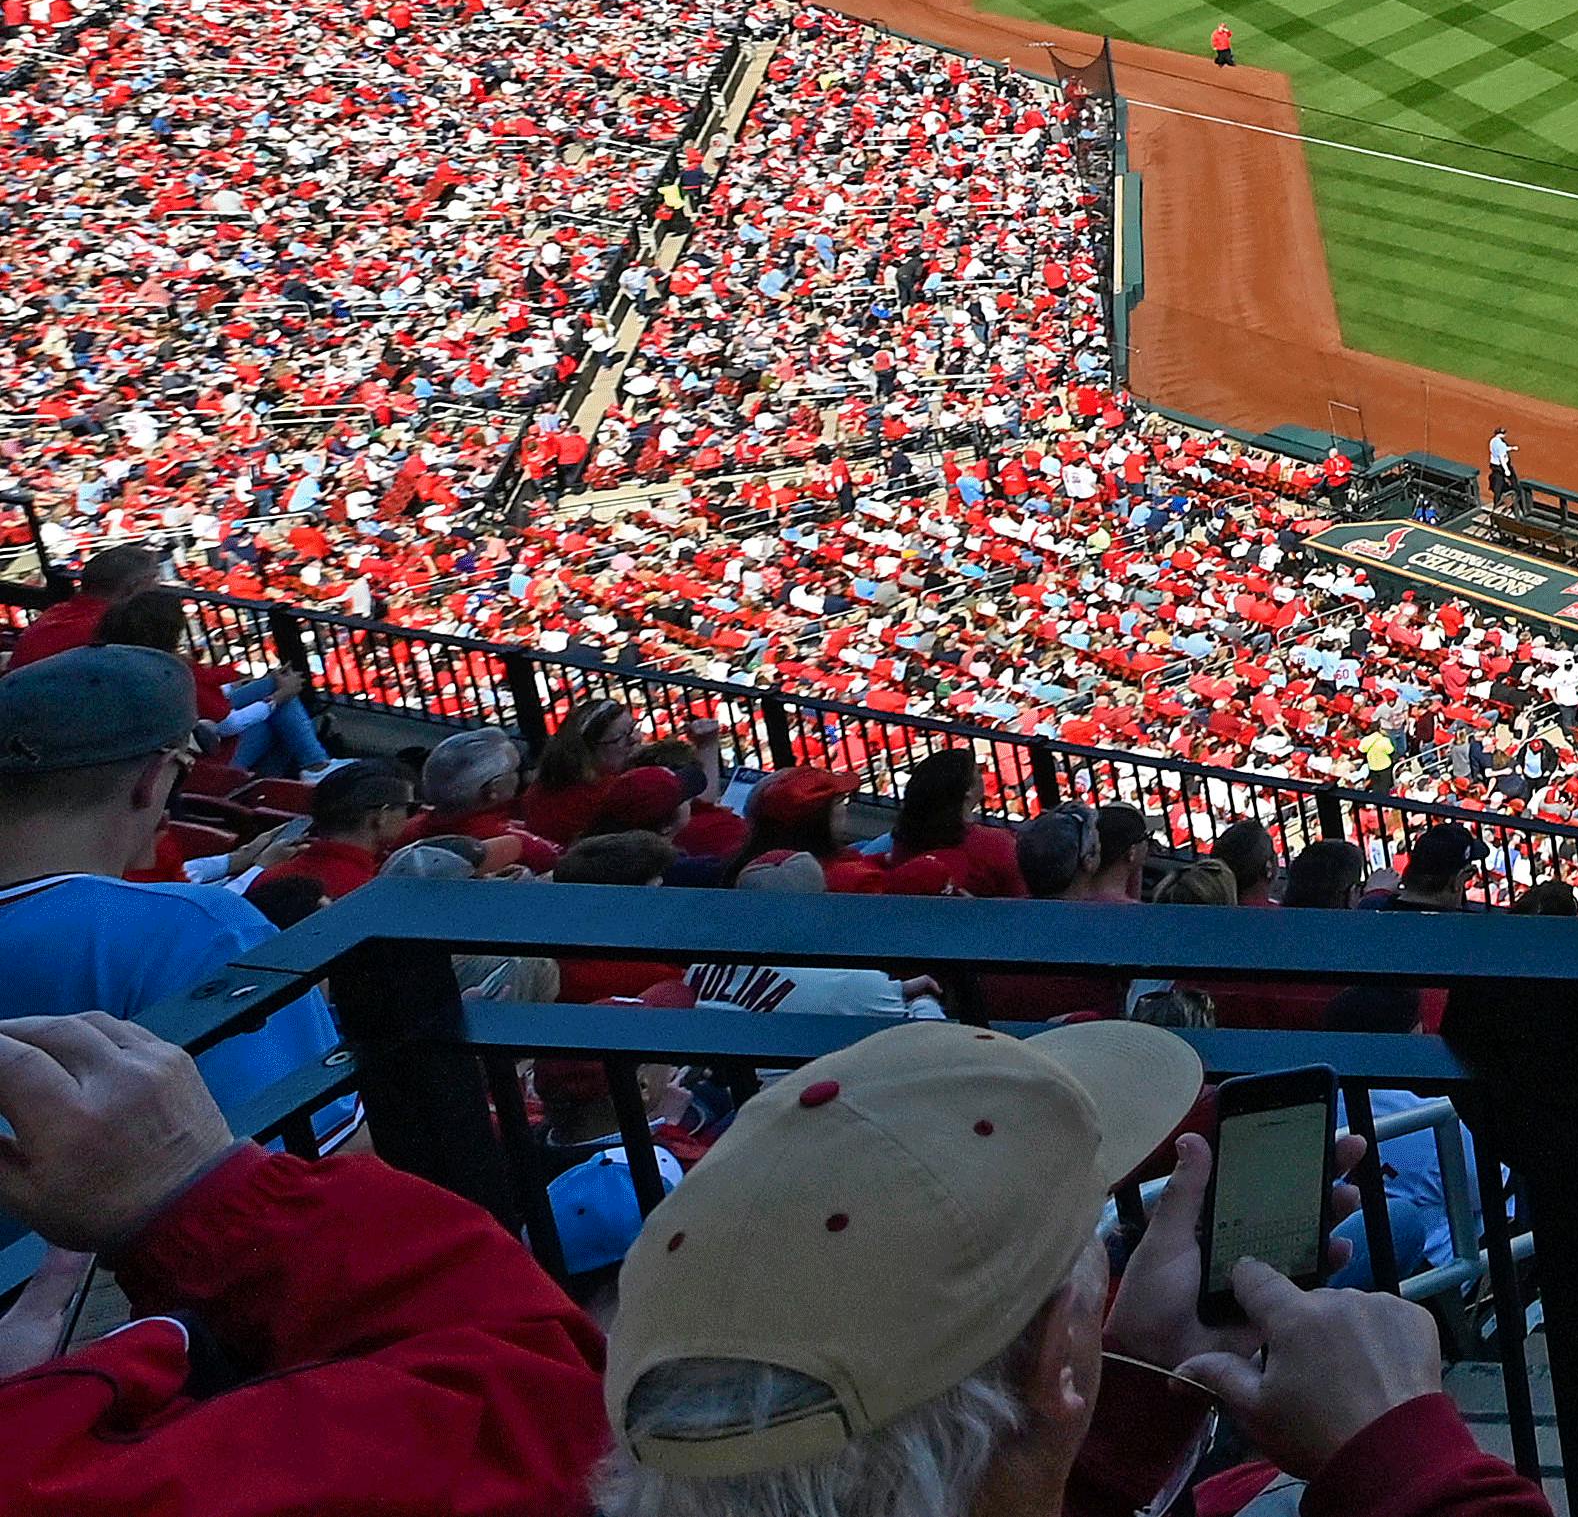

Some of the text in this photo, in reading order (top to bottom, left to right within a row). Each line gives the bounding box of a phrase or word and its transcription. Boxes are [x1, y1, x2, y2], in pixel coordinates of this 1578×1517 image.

[1407, 551, 1537, 597] CHAMPIONS
[1427, 544, 1549, 588] NATIONAL LEAGUE
